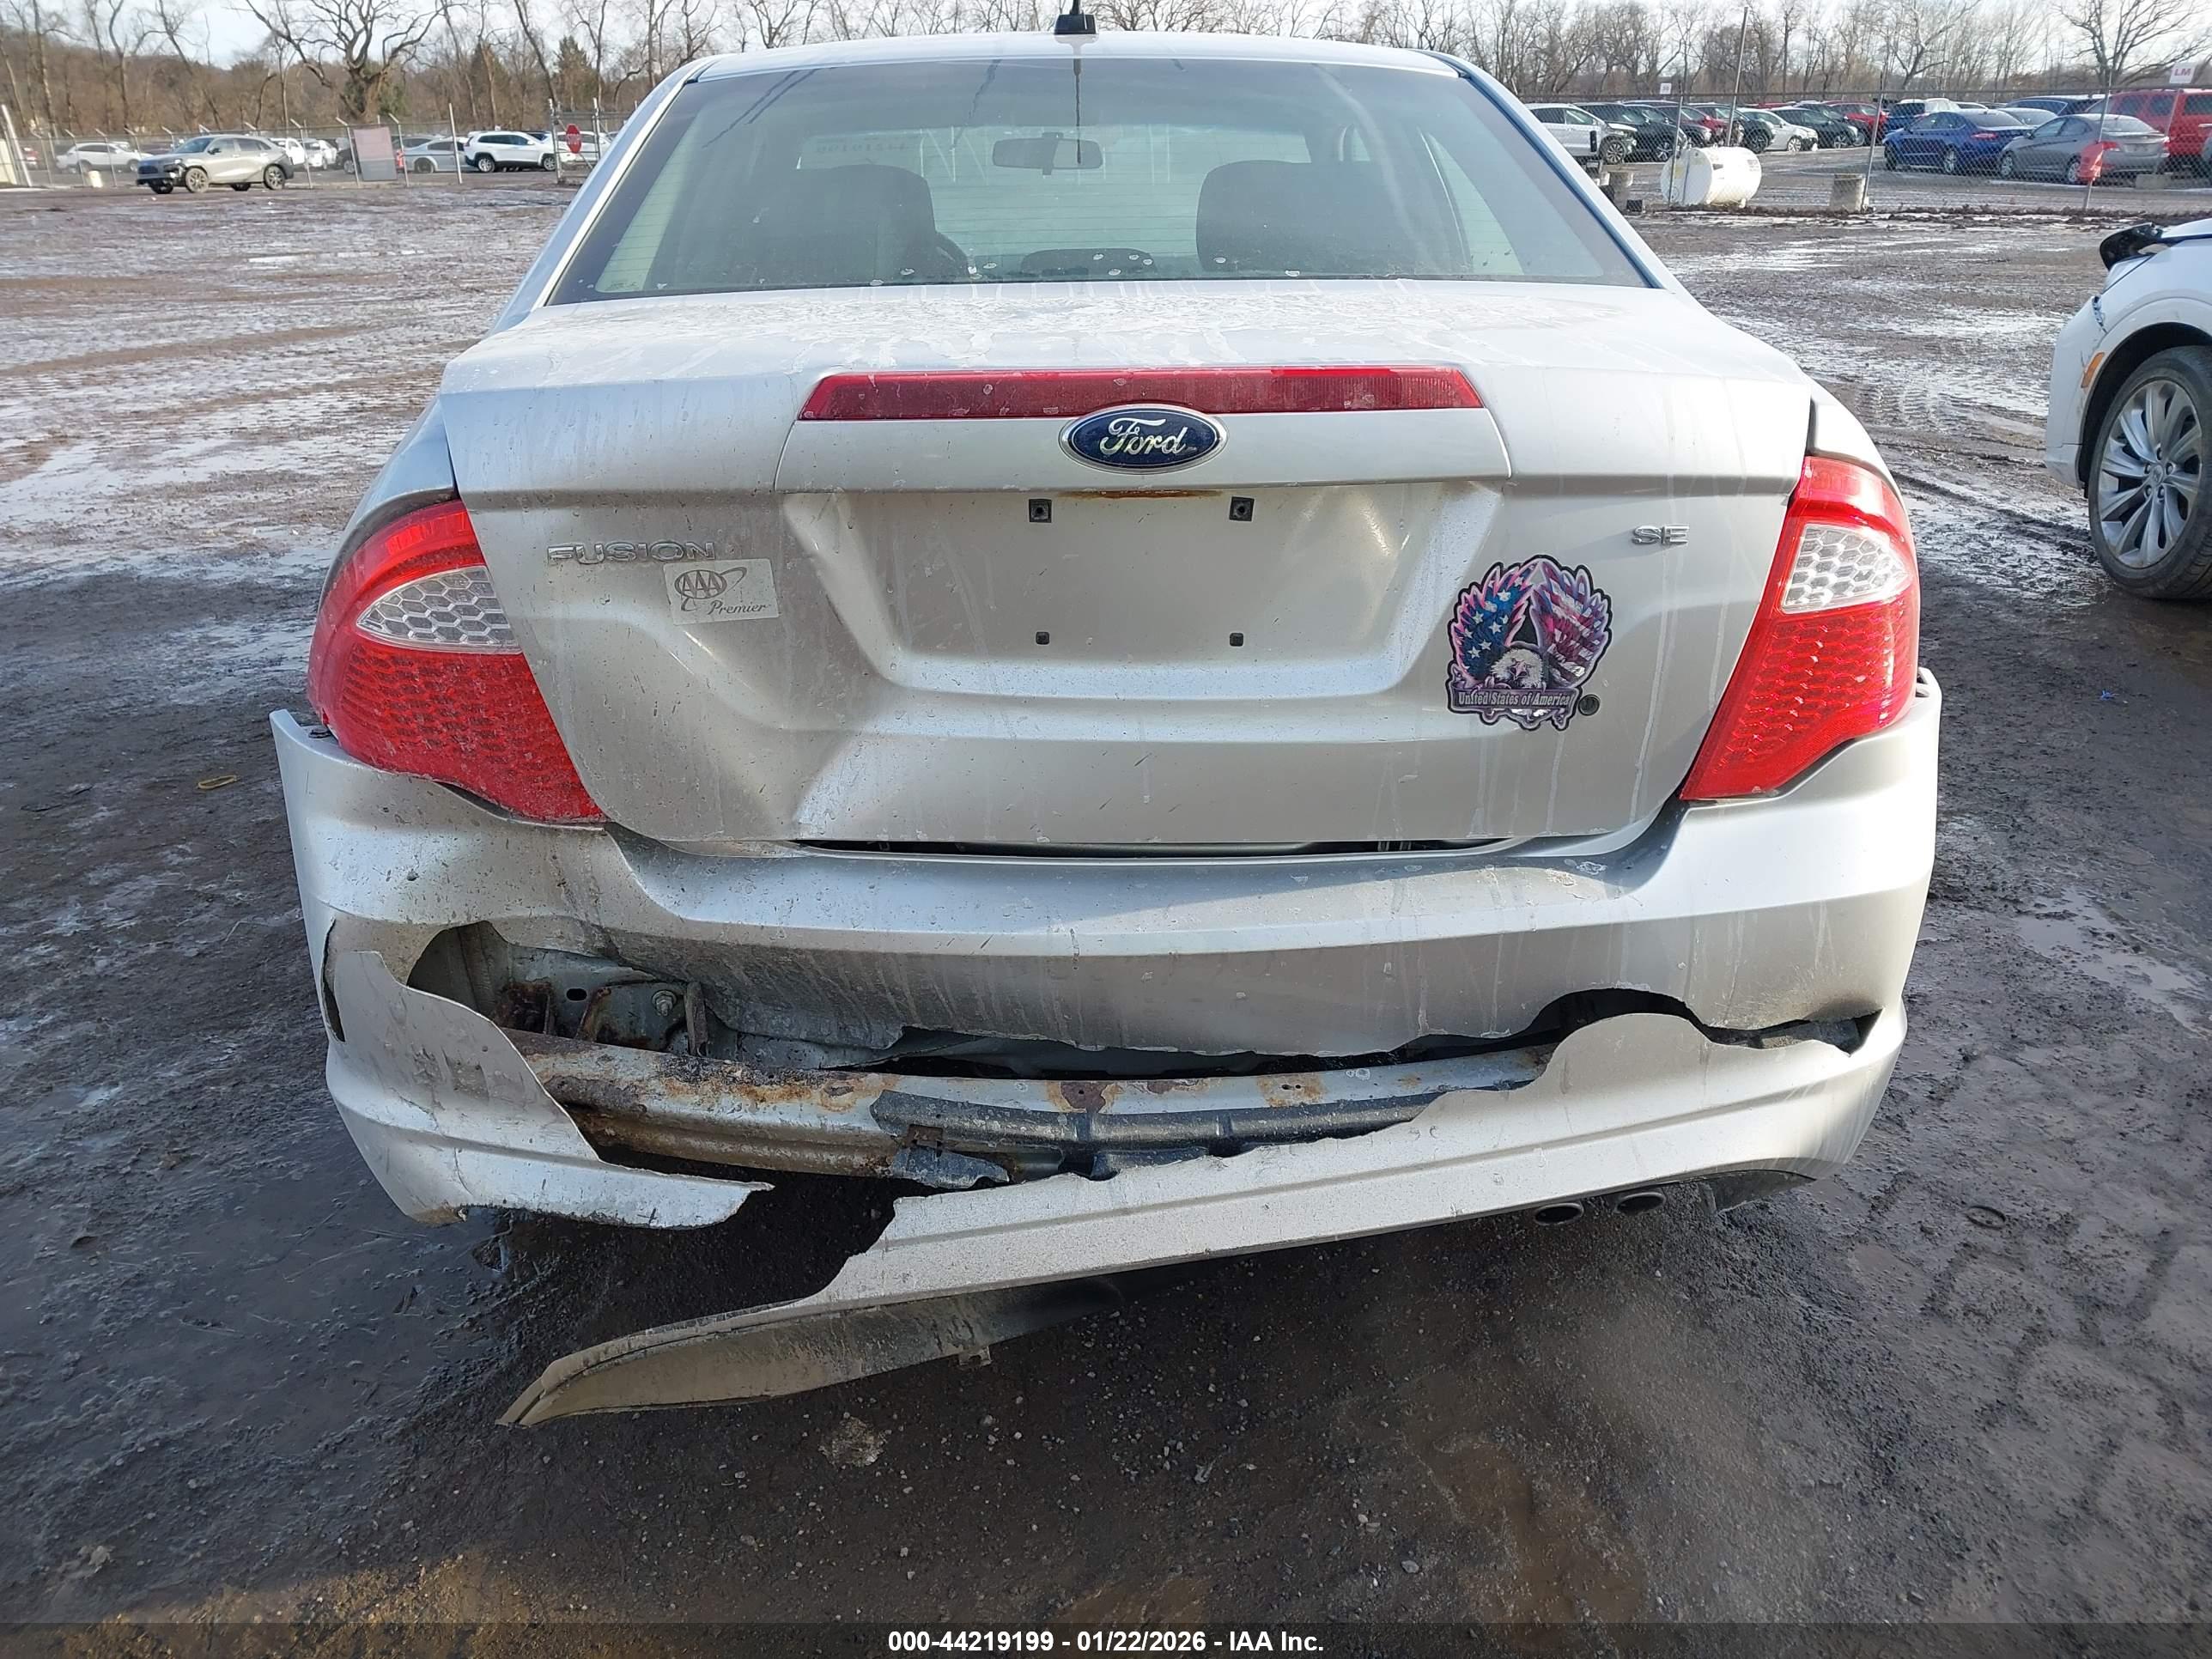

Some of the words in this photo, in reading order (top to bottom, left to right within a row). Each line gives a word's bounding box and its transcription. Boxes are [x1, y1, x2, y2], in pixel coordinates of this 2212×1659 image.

[1100, 418, 1188, 455] Ford
[1632, 525, 1689, 544] SE
[547, 542, 715, 563] FUSION
[679, 570, 724, 599] AAA
[708, 600, 769, 615] Premier
[1458, 692, 1487, 705] United
[1491, 692, 1518, 705] States
[1521, 692, 1531, 705] of
[1533, 692, 1570, 705] America
